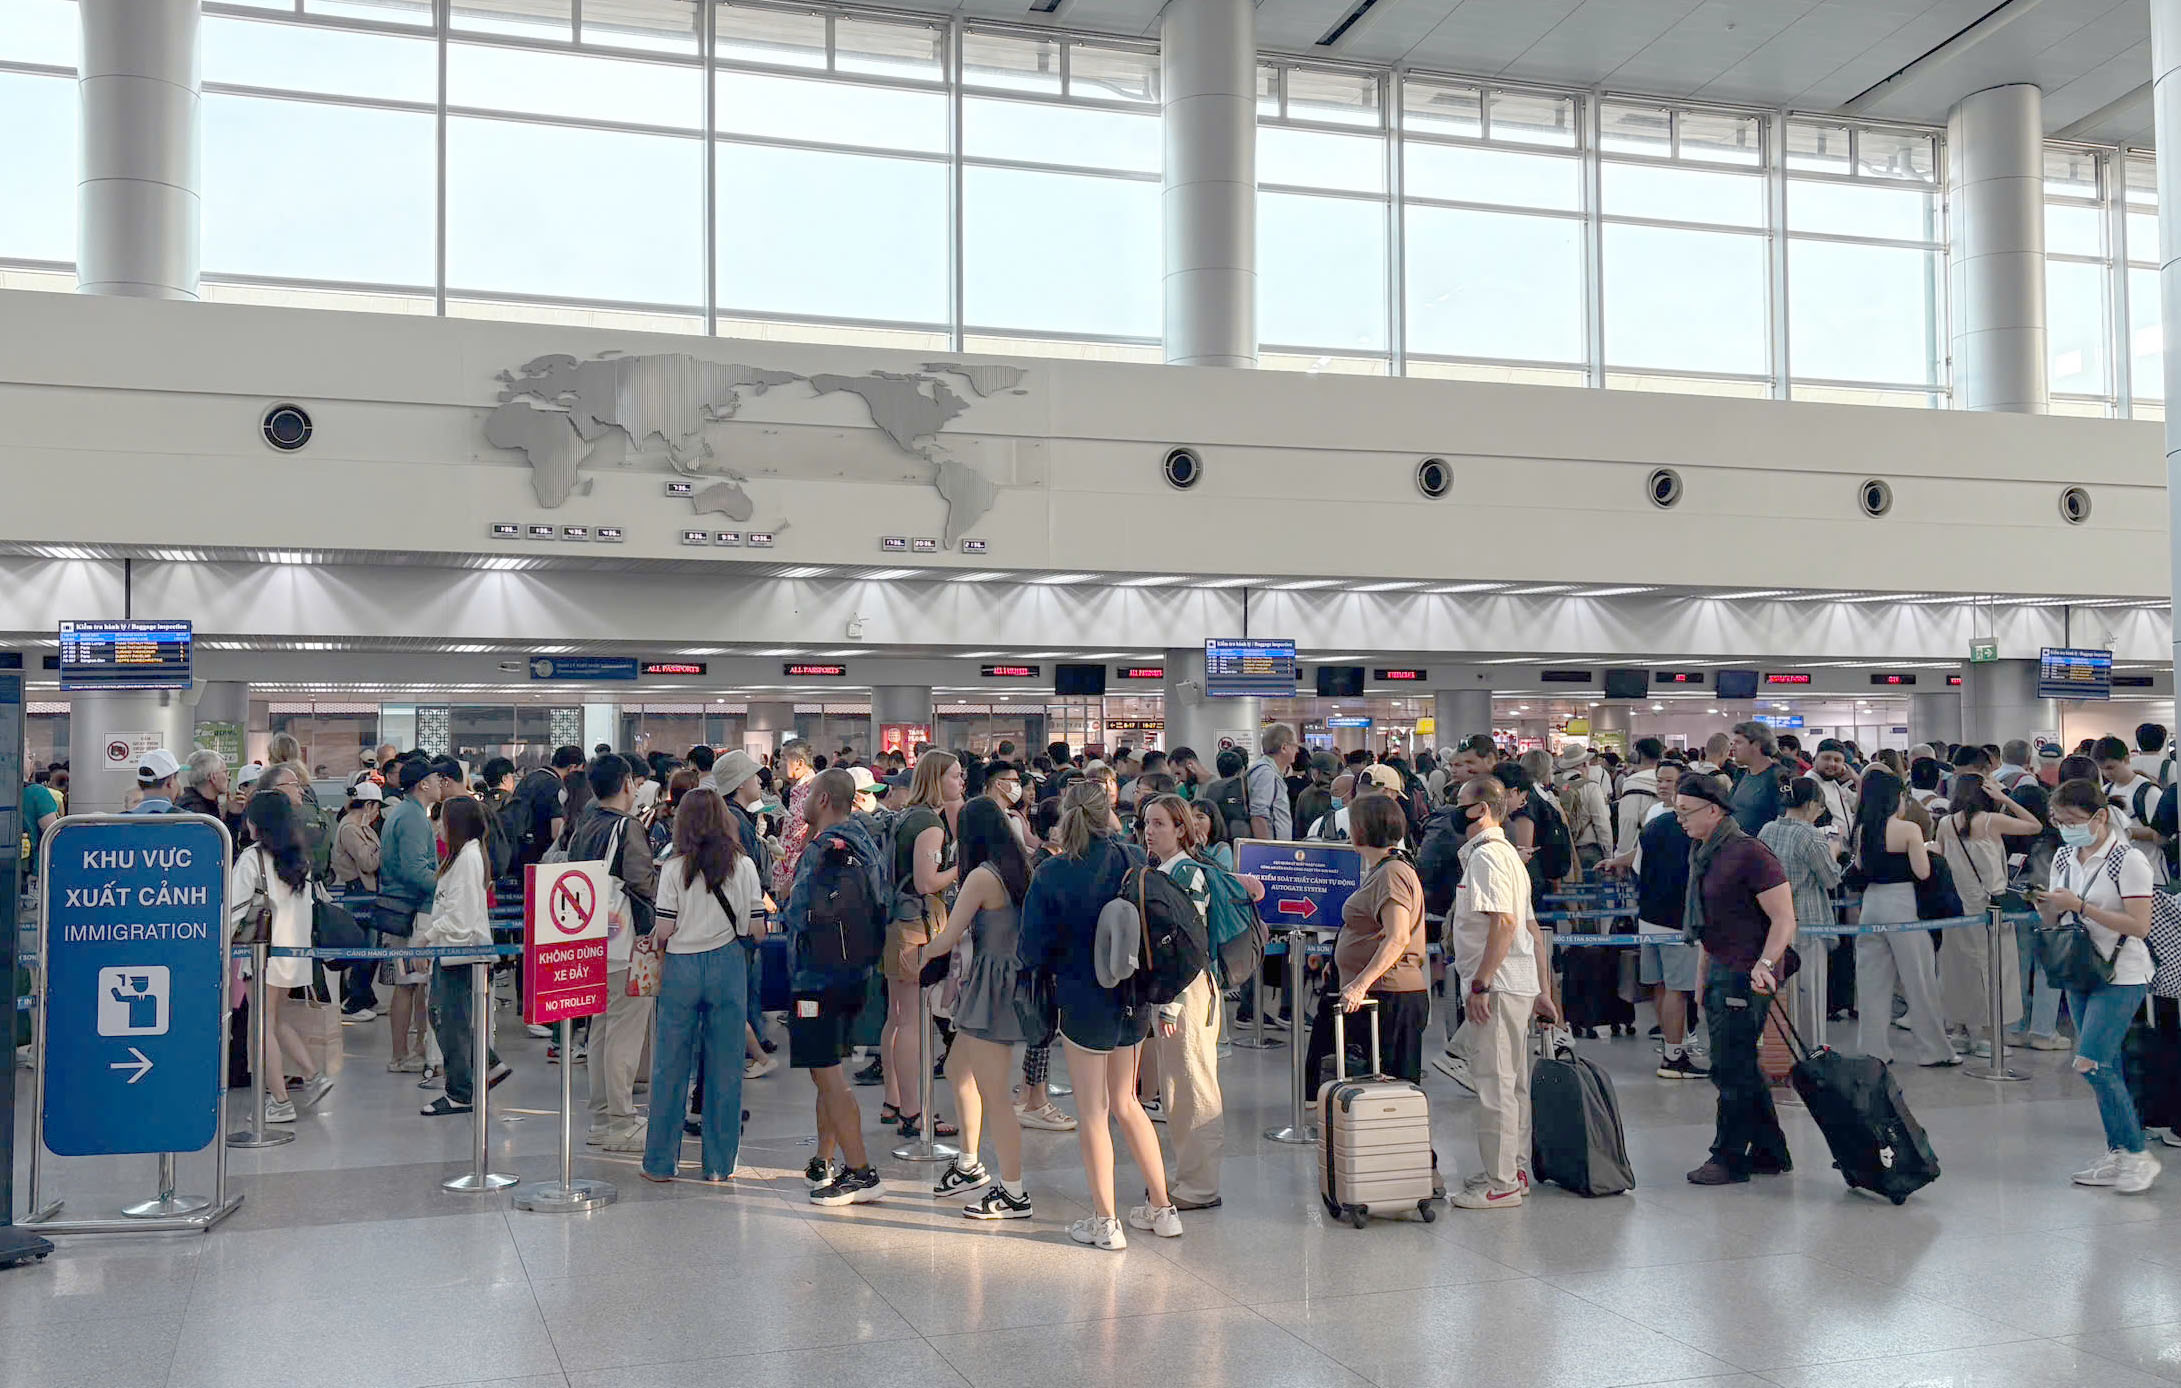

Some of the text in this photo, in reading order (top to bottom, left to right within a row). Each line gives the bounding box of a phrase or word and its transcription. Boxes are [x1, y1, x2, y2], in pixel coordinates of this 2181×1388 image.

[648, 665, 661, 673] ALL
[84, 846, 192, 872] KHU VỰC
[66, 880, 206, 908] XUẤT CẢNH
[1271, 884, 1303, 892] AUTOGATE
[65, 921, 207, 942] IMMIGRATION
[1631, 935, 1652, 943] TIA
[289, 948, 316, 957] TIA
[539, 944, 604, 964] KHÔNG DÙNG
[554, 969, 568, 982] XE
[545, 994, 597, 1012] NO TROLLEY
